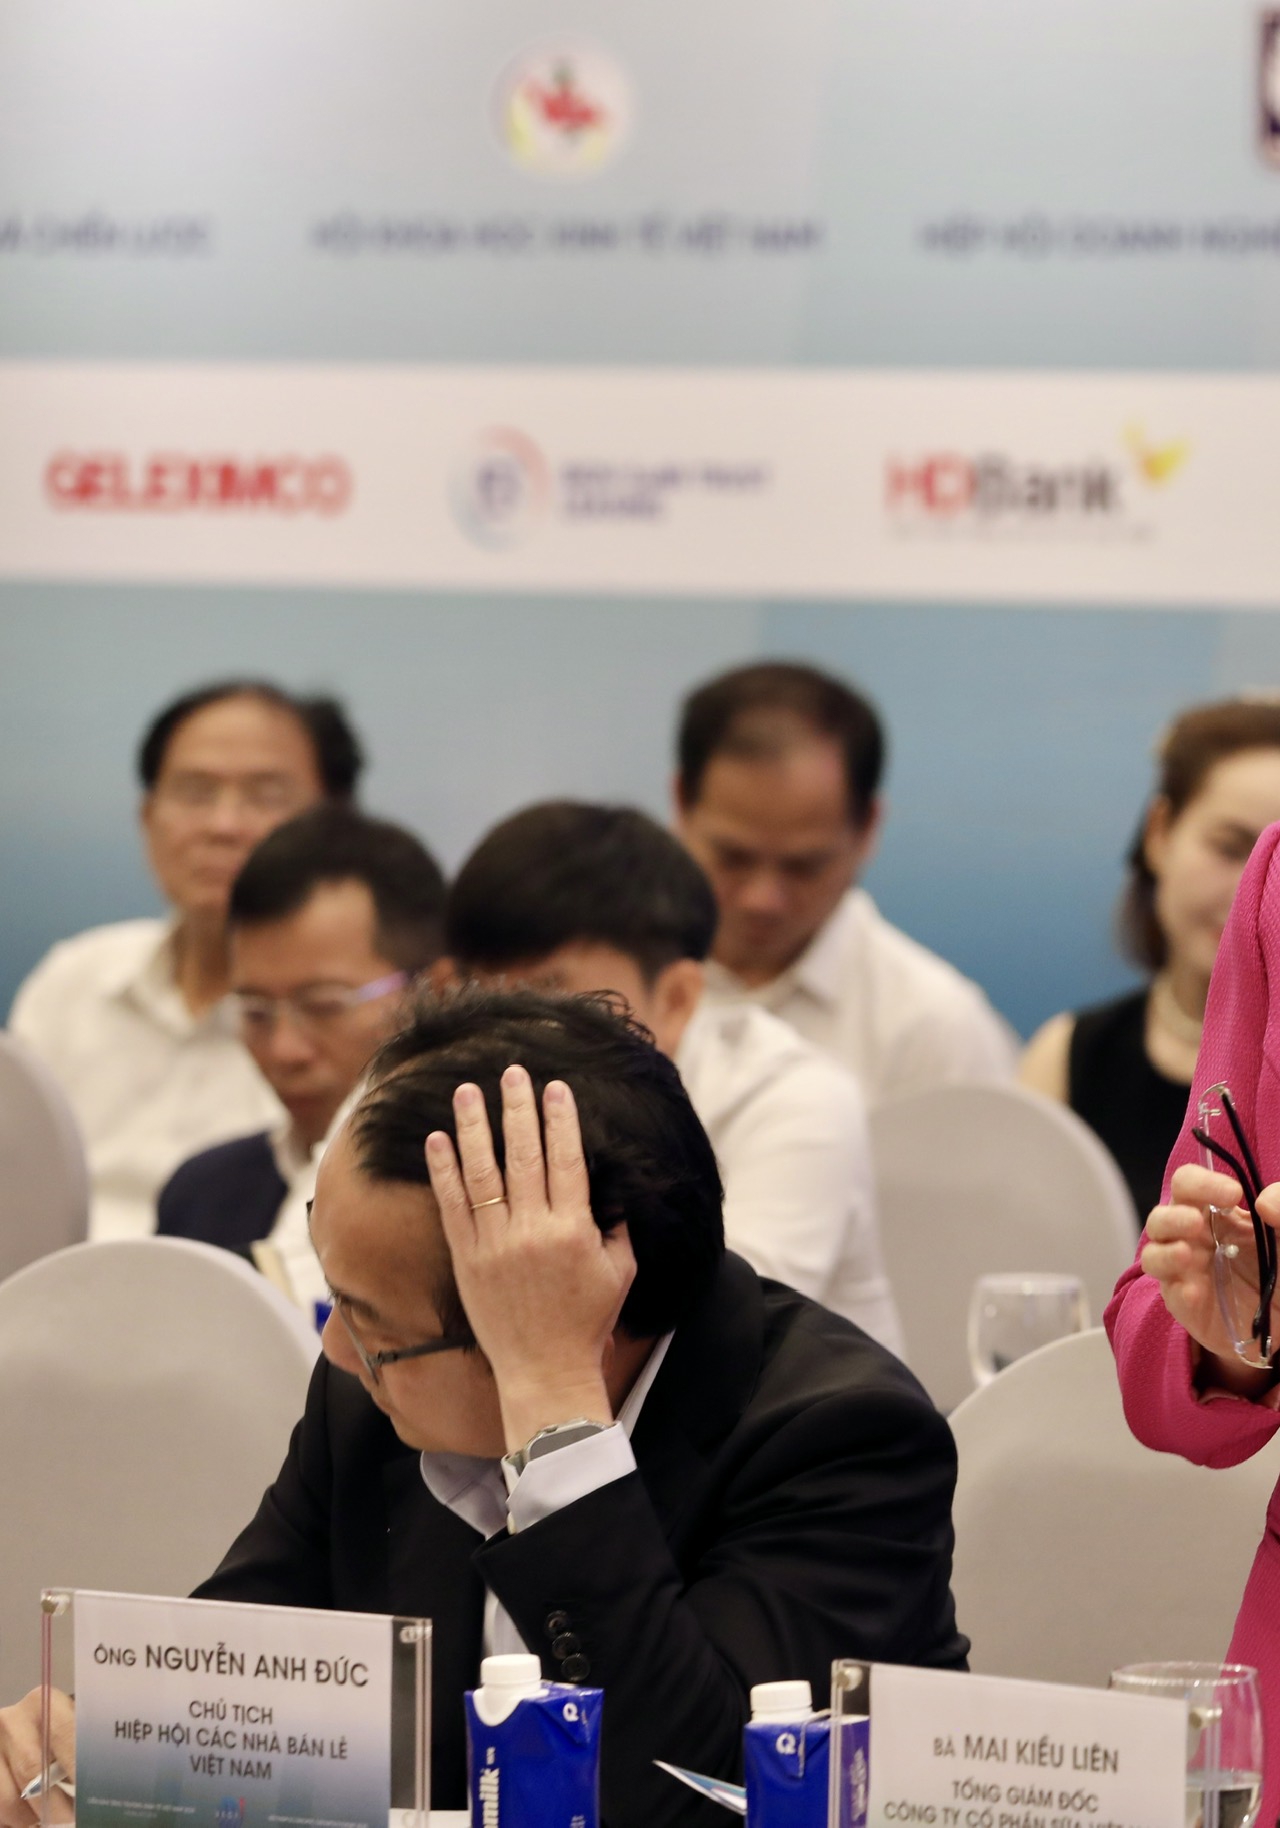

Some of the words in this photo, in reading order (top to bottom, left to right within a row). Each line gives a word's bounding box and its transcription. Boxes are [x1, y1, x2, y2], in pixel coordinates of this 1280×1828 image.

[44, 451, 353, 516] GELEXIMCO
[886, 455, 1120, 518] HDBank
[94, 1643, 137, 1667] ÔNG
[145, 1641, 245, 1677] NGUYỄN
[253, 1653, 307, 1682] ANH
[314, 1655, 369, 1688] ĐỨC
[188, 1698, 227, 1722] CHỦ
[231, 1703, 274, 1727] TỊCH
[114, 1718, 153, 1744] HIỆP
[158, 1722, 191, 1749] HỘI
[196, 1725, 237, 1750] CÁC
[242, 1731, 281, 1755] NHÀ
[286, 1733, 325, 1759] BÁN
[933, 1736, 956, 1758] BÀ
[963, 1734, 1008, 1764] MAI
[1071, 1741, 1120, 1775] LIÊN
[189, 1752, 226, 1778] VIỆT
[229, 1758, 273, 1781] NAM
[883, 1799, 938, 1825] CÔNG
[942, 1806, 961, 1827] TY
[1006, 1783, 1054, 1809] GIÁM
[1058, 1787, 1100, 1814] ĐỐC
